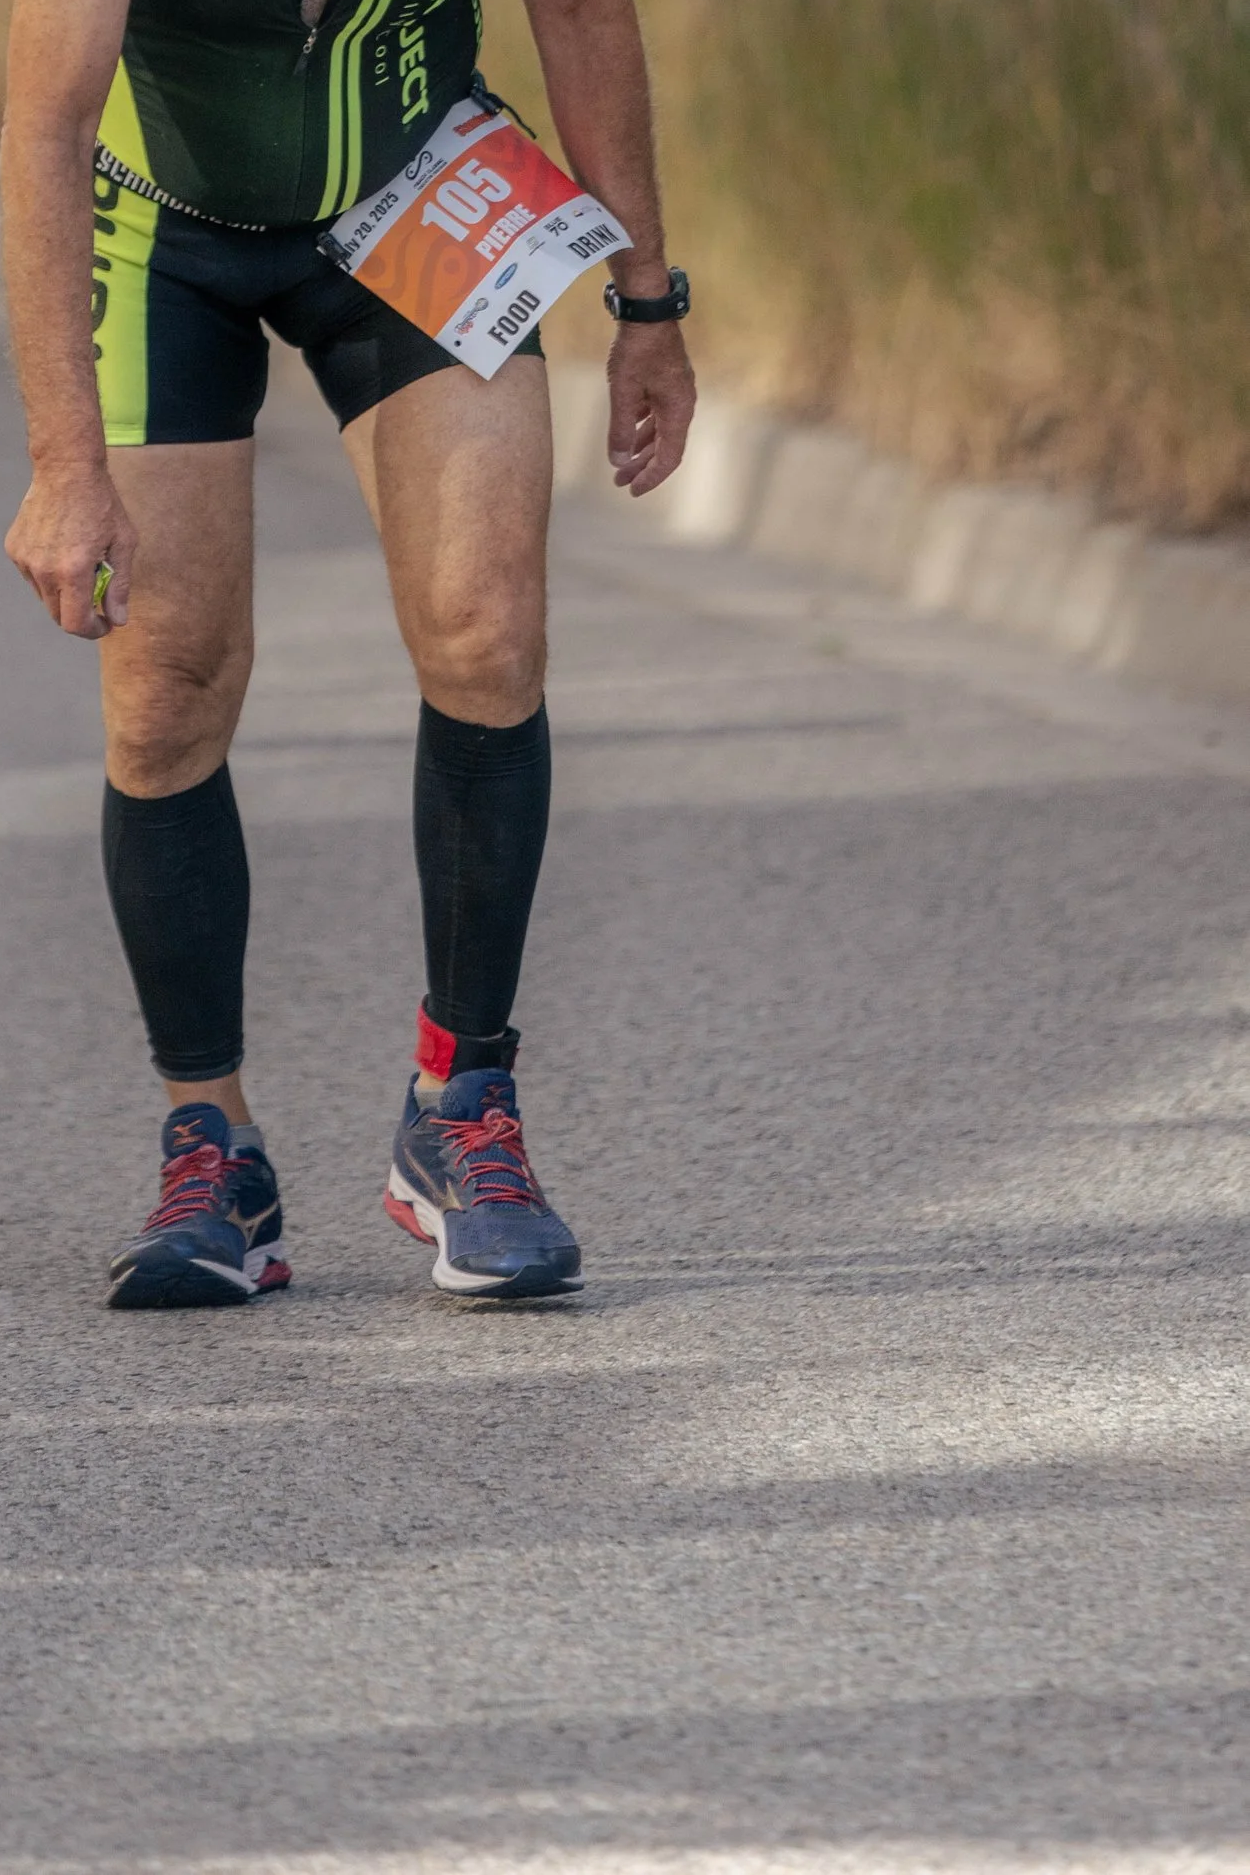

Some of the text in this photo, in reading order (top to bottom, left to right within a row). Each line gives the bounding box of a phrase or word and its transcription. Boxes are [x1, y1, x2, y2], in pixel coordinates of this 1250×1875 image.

[369, 191, 399, 223] 2025
[420, 158, 512, 242] 105
[473, 203, 537, 262] PIERRE
[549, 221, 569, 237] 70
[566, 223, 620, 260] DRINK
[487, 290, 541, 346] FOOD
